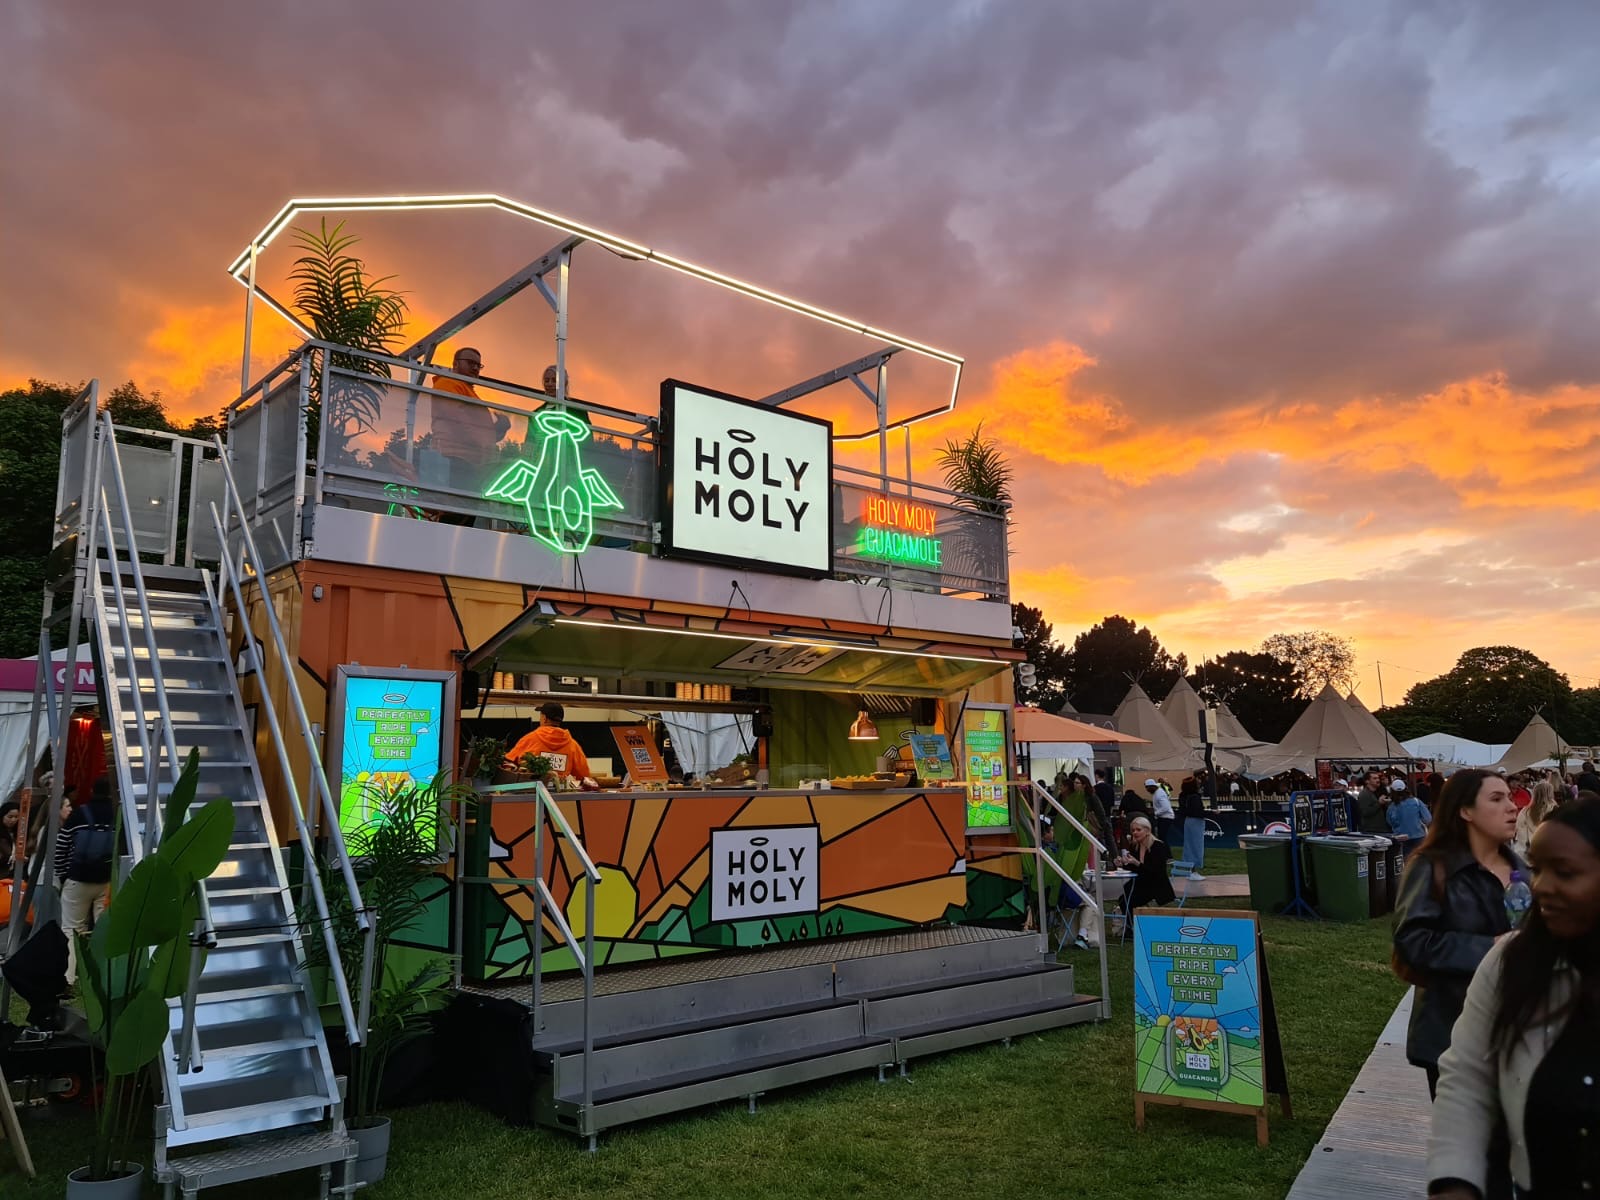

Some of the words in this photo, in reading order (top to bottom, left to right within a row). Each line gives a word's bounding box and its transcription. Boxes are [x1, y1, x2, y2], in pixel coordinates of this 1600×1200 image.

[695, 437, 810, 491] HOLY
[695, 480, 810, 532] MOLY
[867, 496, 900, 526] HOLY
[904, 504, 936, 533] MOLY
[865, 527, 942, 566] GUACAMOLE
[362, 710, 425, 720] PERFECTLY
[381, 723, 406, 733] RIPE
[374, 735, 412, 745] EVERY
[379, 748, 406, 757] TIME
[728, 847, 805, 876] HOLY
[728, 876, 805, 907] MOLY
[1157, 944, 1231, 957] PERFECTLY
[1179, 960, 1209, 971] RIPE
[1173, 974, 1216, 986] EVERY
[1180, 989, 1211, 1001] TIME
[1180, 1073, 1218, 1082] GUACAMOLE
